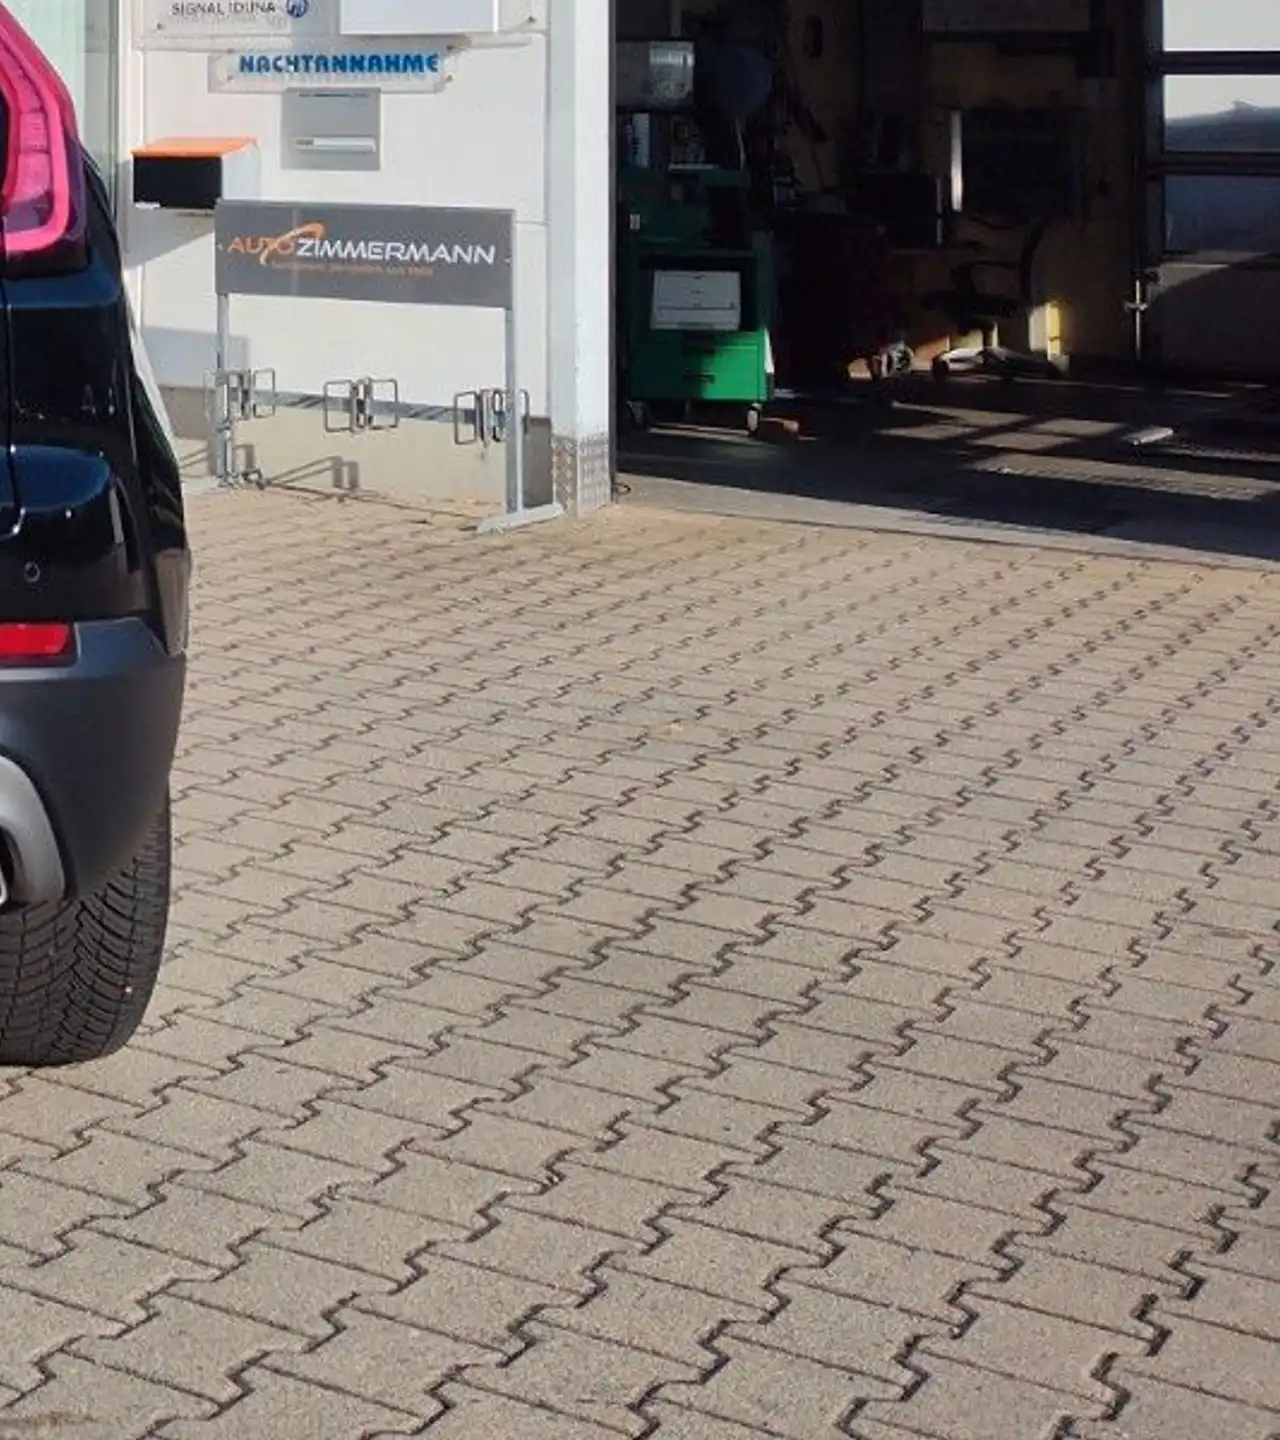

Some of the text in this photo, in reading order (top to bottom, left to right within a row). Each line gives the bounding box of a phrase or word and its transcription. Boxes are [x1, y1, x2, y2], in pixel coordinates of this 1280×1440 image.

[171, 0, 276, 16] SIGNAL IDUNA
[239, 52, 439, 75] NACHTANNAHME
[227, 235, 497, 265] AUTO ZIMMERMANN
